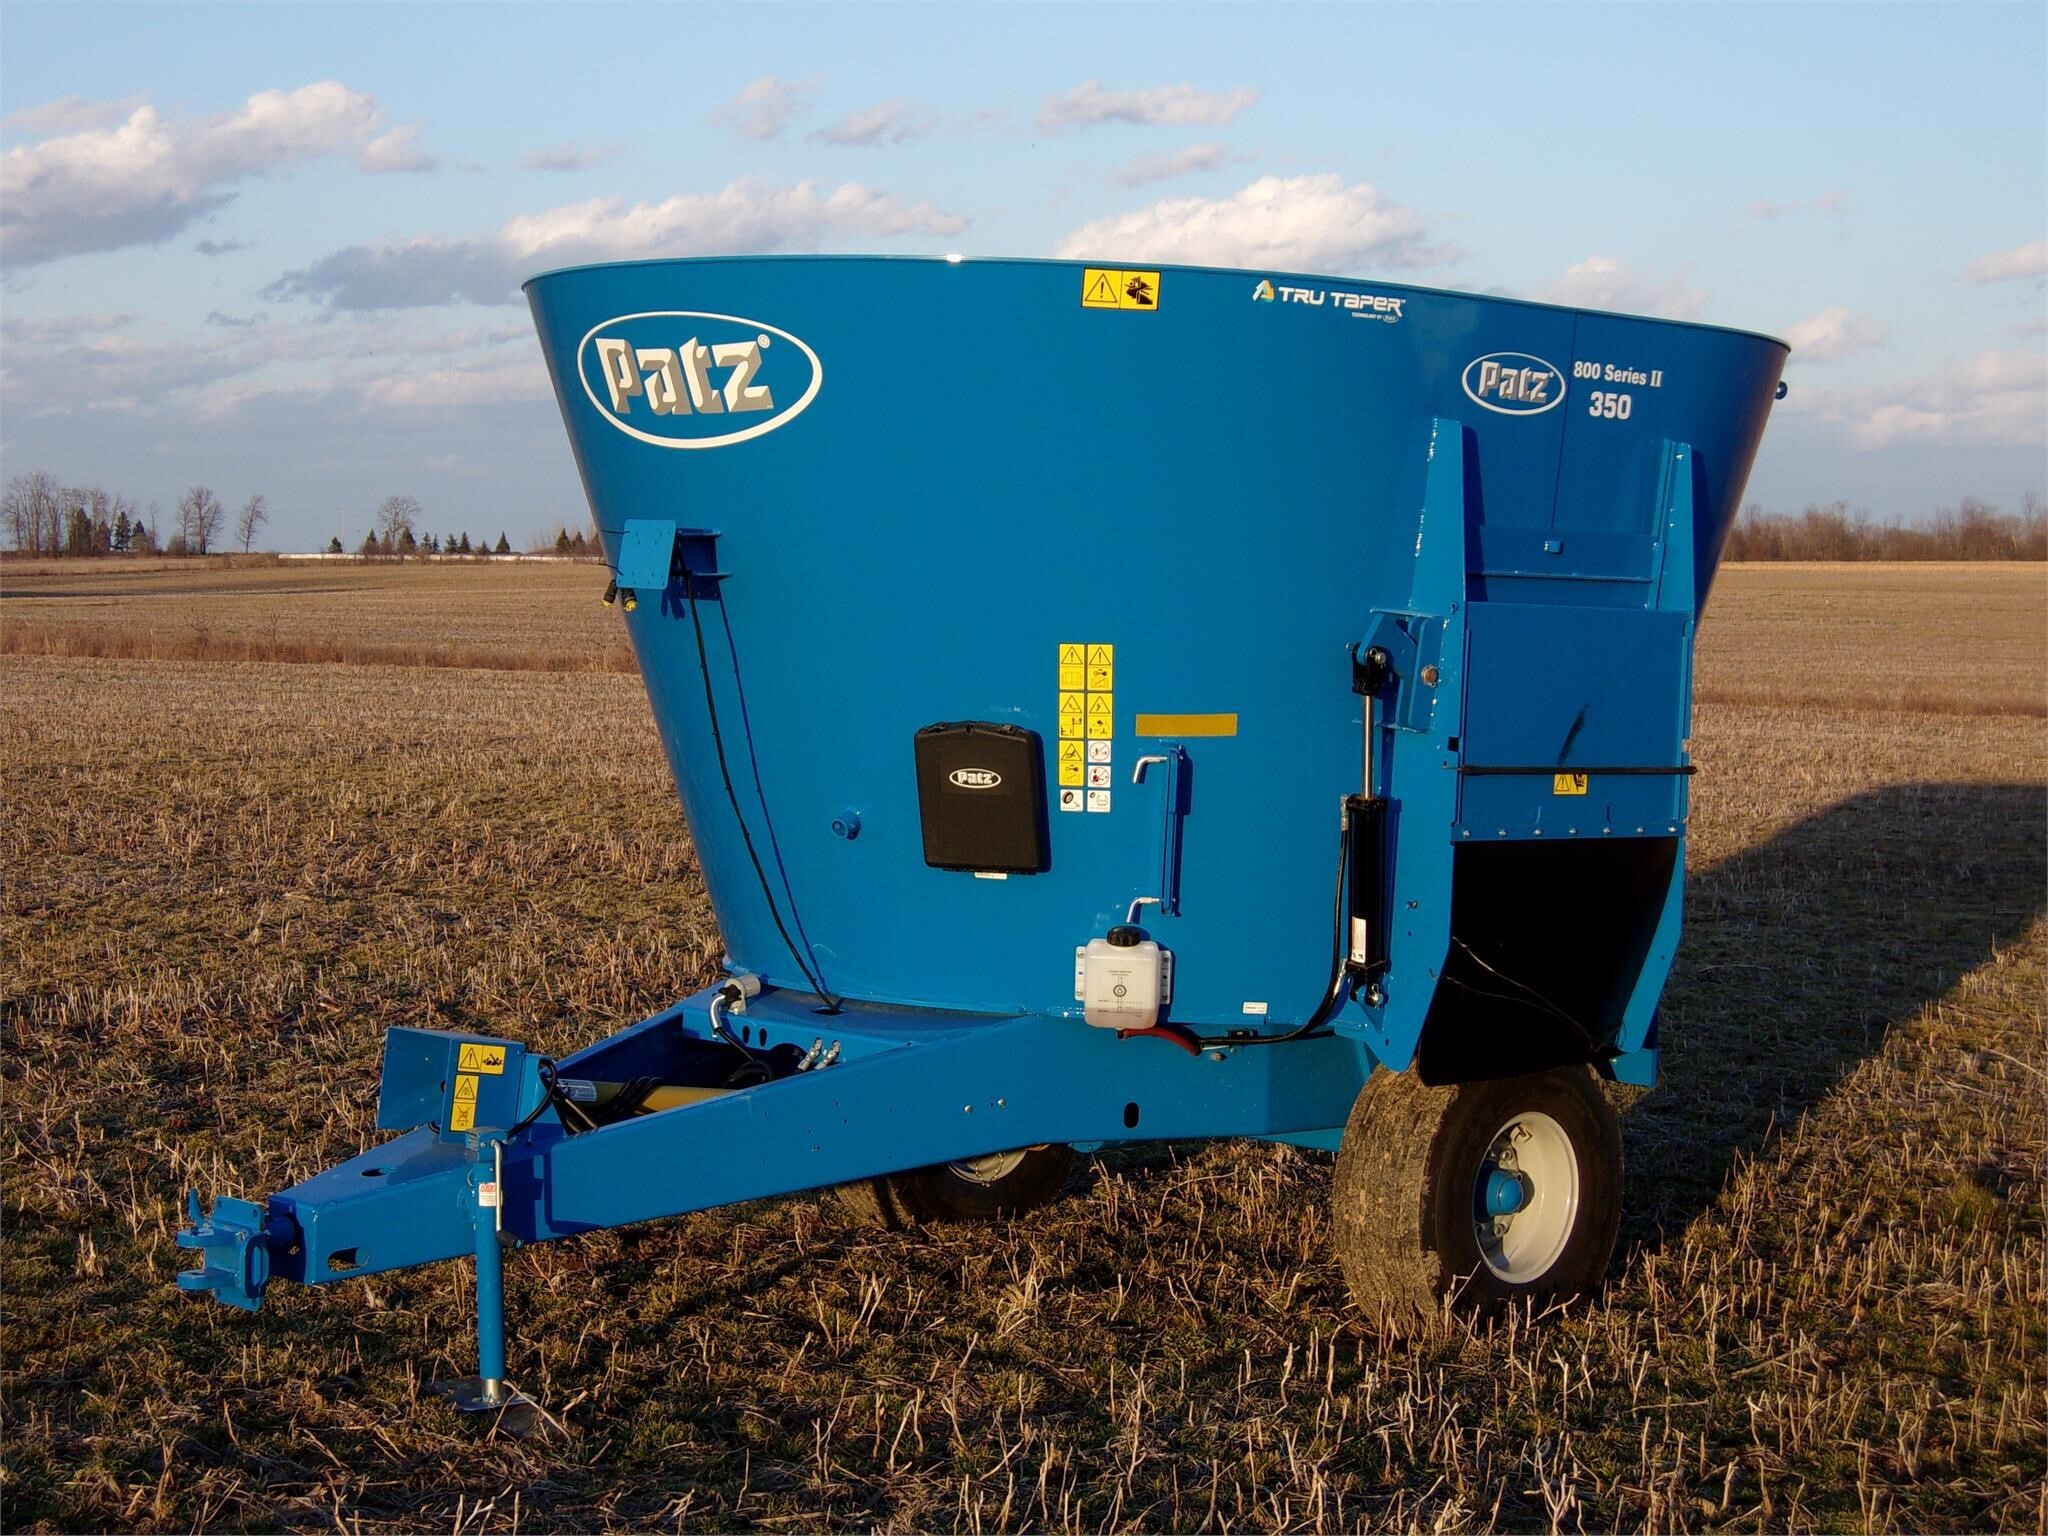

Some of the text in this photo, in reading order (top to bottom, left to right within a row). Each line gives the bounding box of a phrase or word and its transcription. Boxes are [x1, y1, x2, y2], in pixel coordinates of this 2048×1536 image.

[1278, 286, 1326, 306] TRU
[595, 336, 774, 416] Patz
[1478, 360, 1550, 403] Patz
[1573, 360, 1664, 388] 800 Series II
[1589, 390, 1632, 420] 350
[957, 771, 993, 784] Patz
